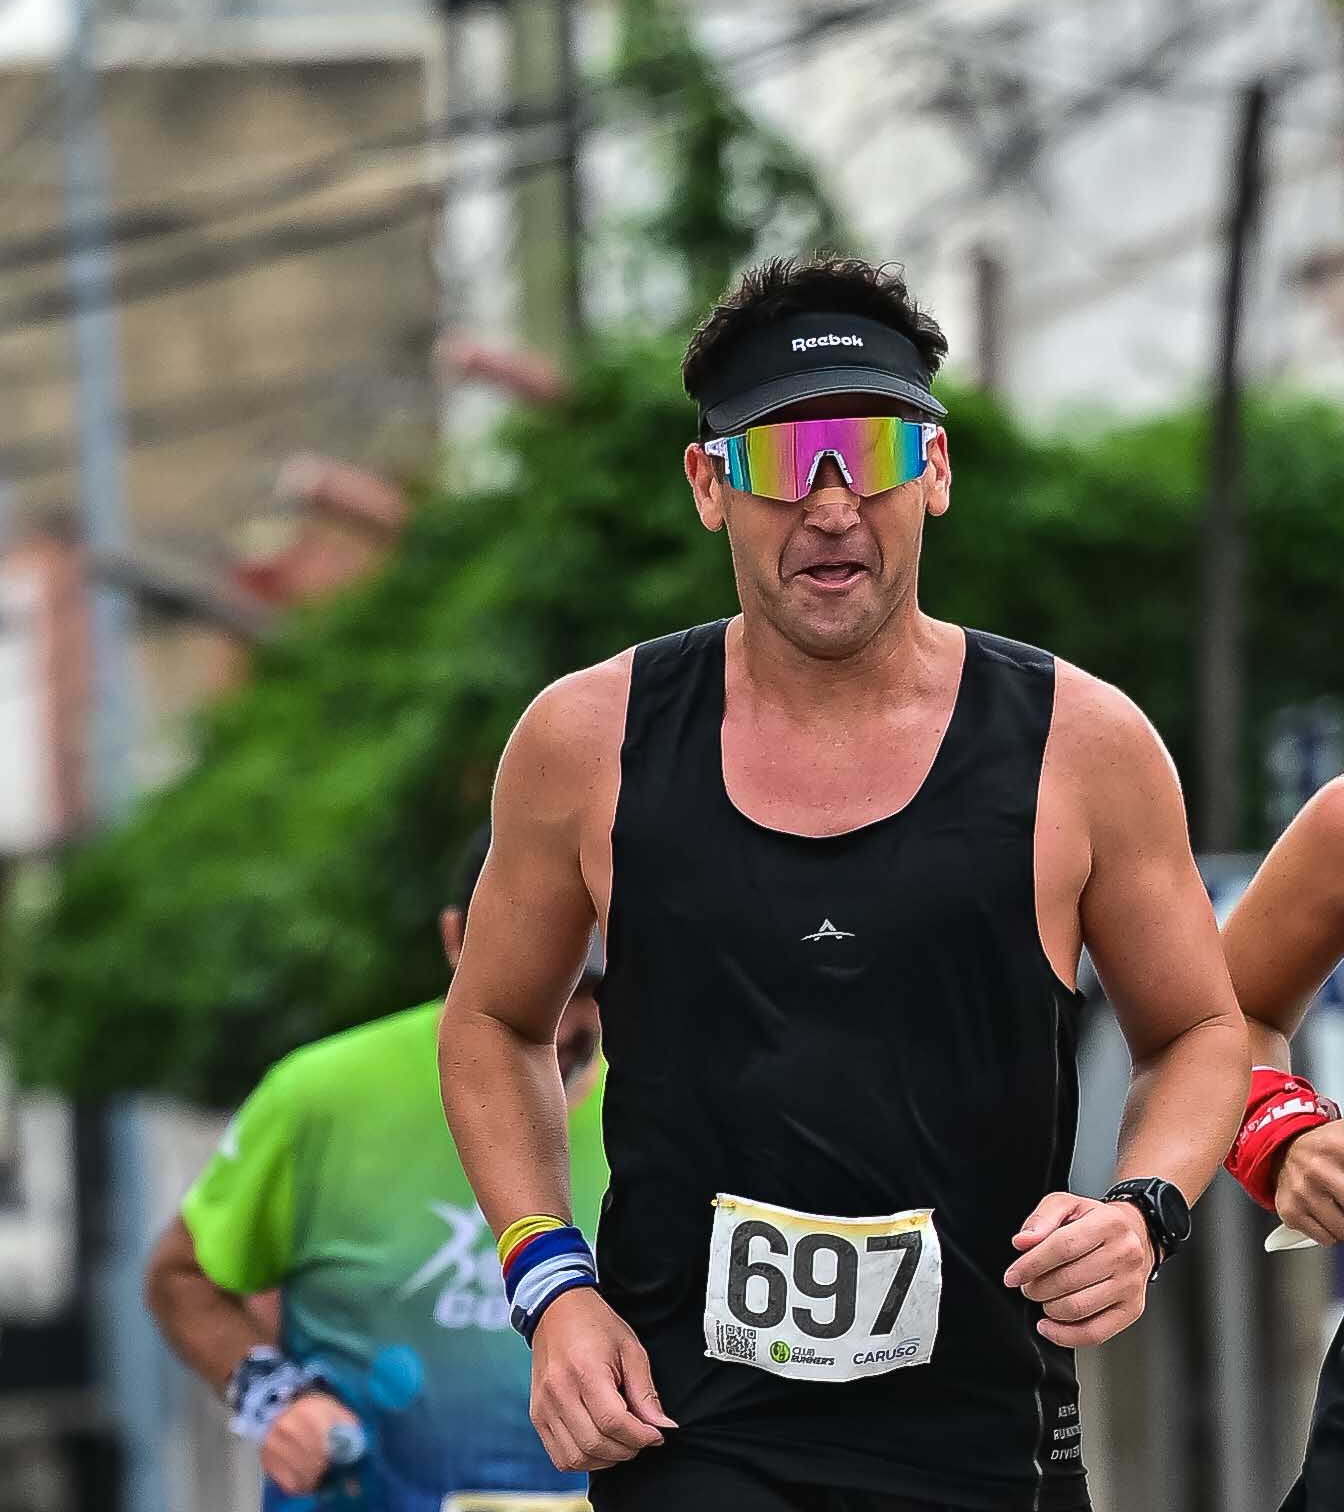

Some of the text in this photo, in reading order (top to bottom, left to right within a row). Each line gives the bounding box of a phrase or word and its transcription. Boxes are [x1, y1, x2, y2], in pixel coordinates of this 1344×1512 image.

[791, 333, 864, 352] Reebok
[727, 1219, 923, 1340] 697
[852, 1345, 918, 1366] CARUSO
